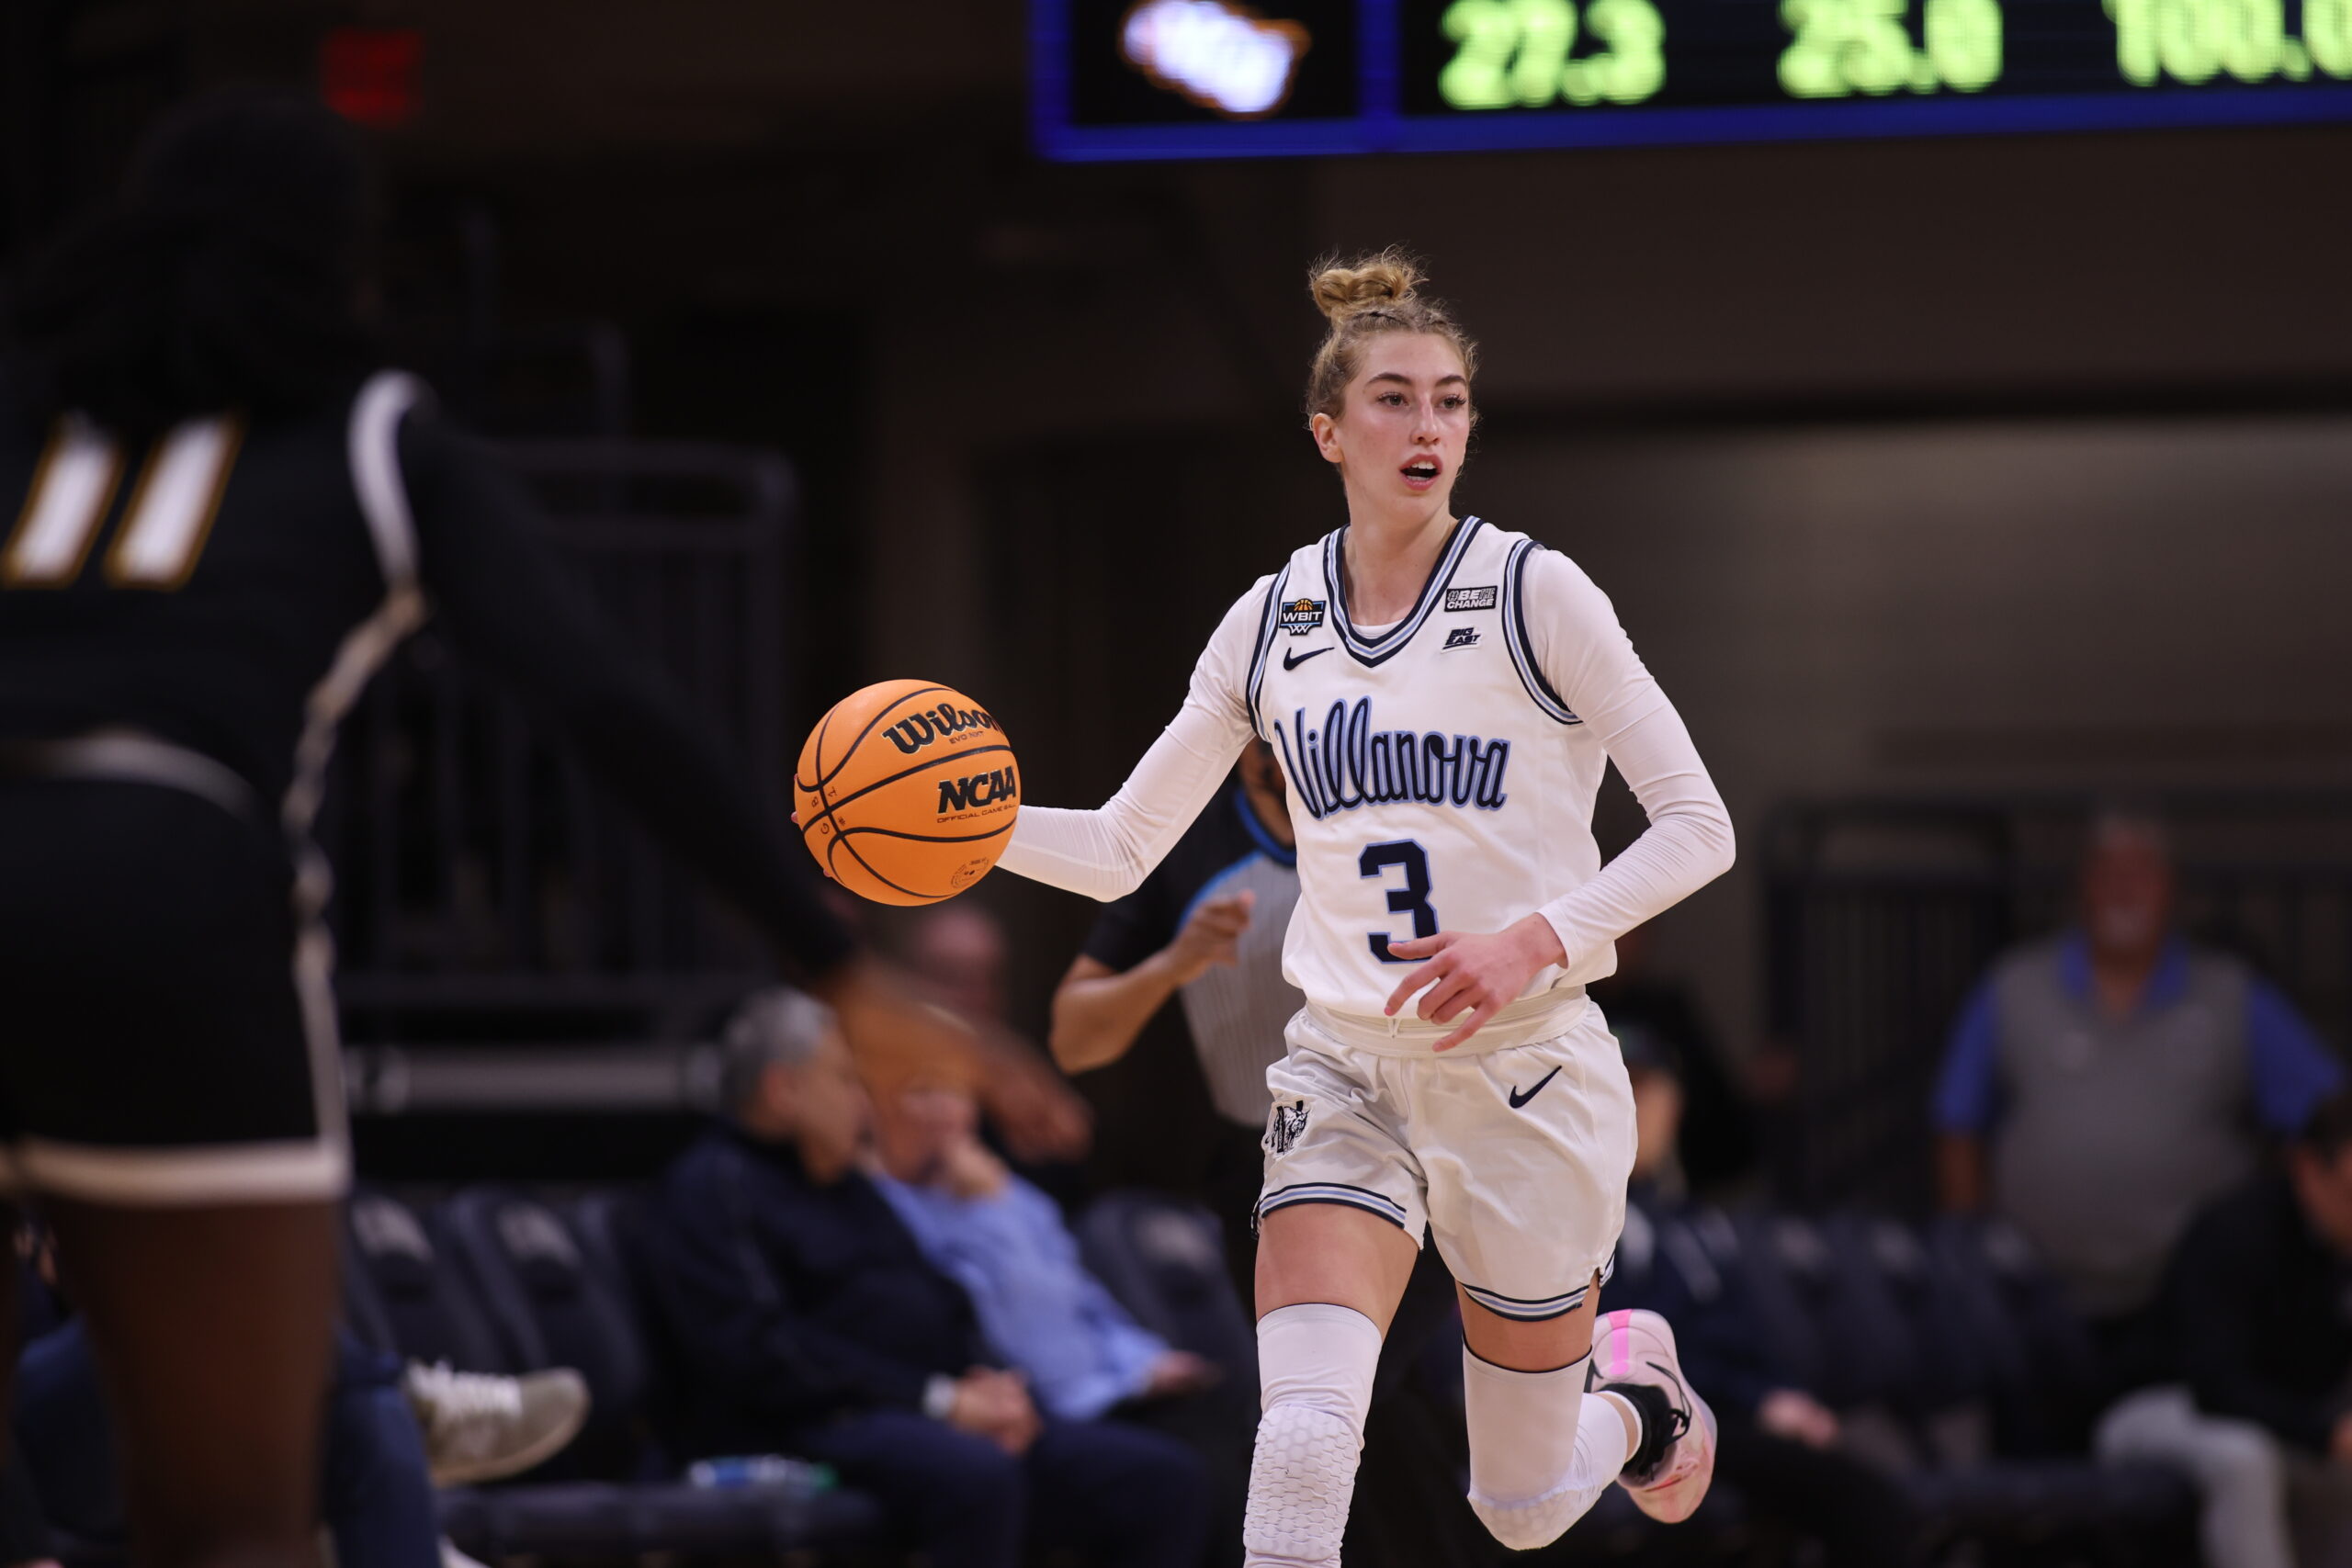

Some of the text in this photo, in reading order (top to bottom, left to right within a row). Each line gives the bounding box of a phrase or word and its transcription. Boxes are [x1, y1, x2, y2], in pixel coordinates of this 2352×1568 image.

[2, 411, 246, 590] 11
[1283, 611, 1323, 622] WBIT
[1446, 598, 1494, 609] CHANGE
[949, 734, 967, 744] EVO
[1273, 694, 1511, 820] Villanova
[937, 765, 1017, 814] NCAA
[937, 813, 980, 823] OFFICIAL
[1359, 838, 1441, 964] 3
